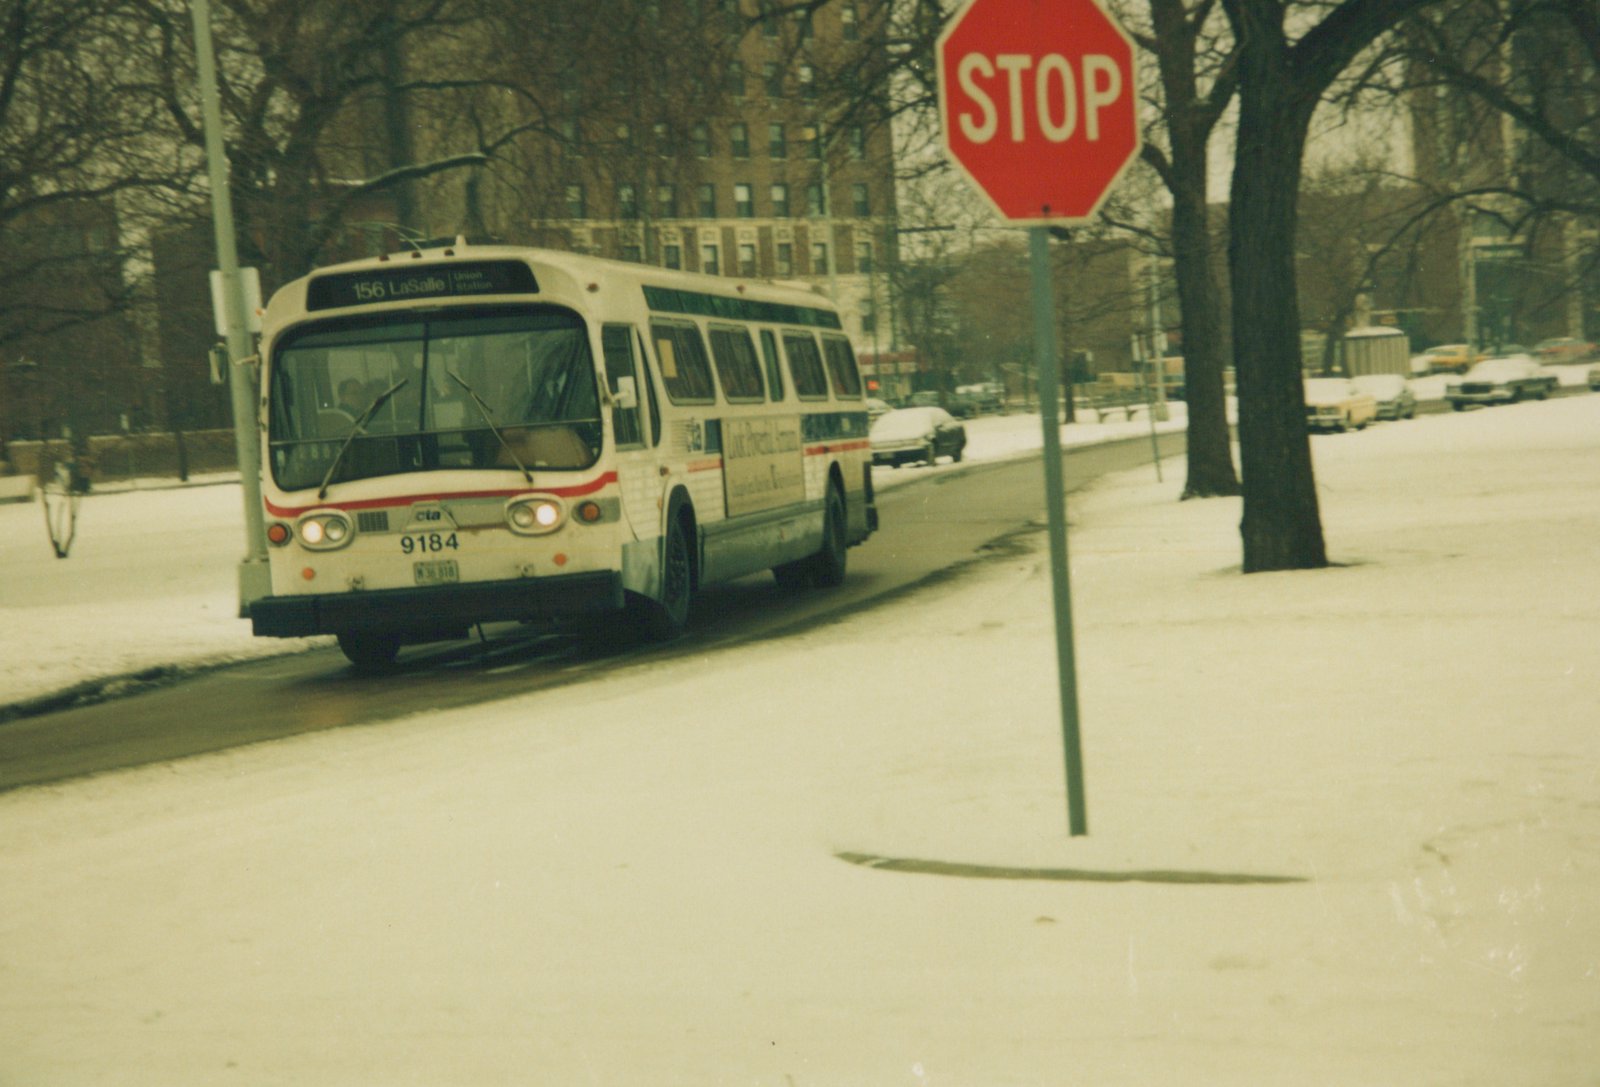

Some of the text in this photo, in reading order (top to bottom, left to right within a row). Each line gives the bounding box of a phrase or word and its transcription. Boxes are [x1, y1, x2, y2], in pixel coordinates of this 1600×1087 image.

[957, 52, 1122, 144] STOP
[454, 271, 483, 281] Union
[352, 276, 445, 300] 156 LaSalle
[416, 510, 441, 522] cta
[401, 532, 459, 554] 9184
